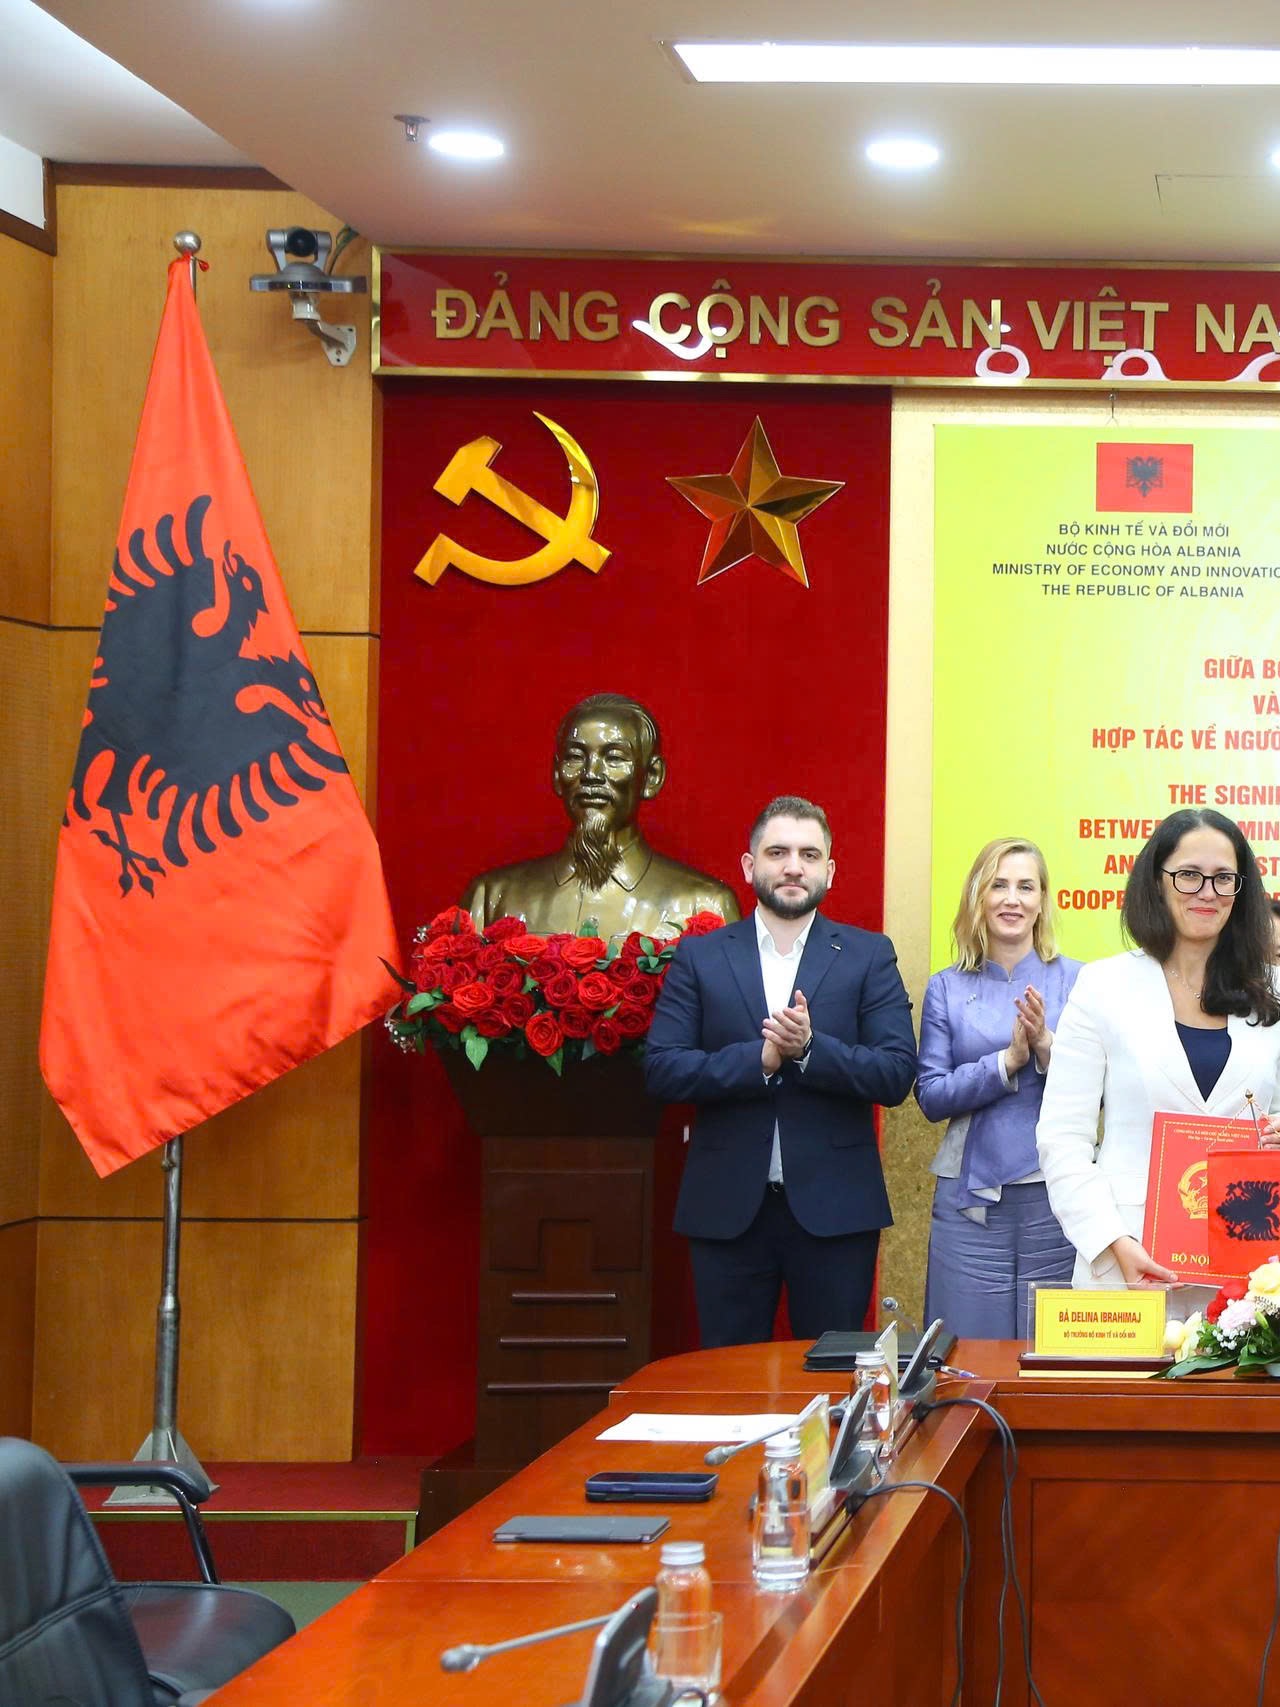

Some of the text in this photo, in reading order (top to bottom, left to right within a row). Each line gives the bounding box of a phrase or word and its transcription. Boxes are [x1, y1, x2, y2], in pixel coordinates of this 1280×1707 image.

[431, 272, 620, 342] ĐẢNG
[648, 280, 841, 359] CỘNG
[869, 279, 1002, 350] SẢN
[1024, 285, 1169, 368] VIỆT
[1059, 520, 1228, 537] BỘ KINH TẾ VÀ ĐỔI MỚI
[1047, 541, 1240, 558] NƯỚC CỘNG HÒA ALBANIA
[993, 563, 1061, 575] MINISTRY
[1067, 564, 1086, 575] OF
[1092, 564, 1165, 576] ECONOMY
[1171, 566, 1201, 576] AND
[1042, 584, 1243, 597] THE REPUBLIC OF ALBANIA
[1204, 653, 1254, 679] GIỮA
[1253, 691, 1280, 714] VÀ
[1093, 727, 1135, 753] HỢP
[1143, 725, 1183, 749] TÁC
[1192, 725, 1216, 749] VỀ
[1168, 784, 1206, 804] THE
[1079, 819, 1162, 839] BETWE
[1104, 854, 1134, 874] AN
[1071, 1312, 1098, 1322] DELINA
[1101, 1312, 1141, 1323] IBRAHIMAJ
